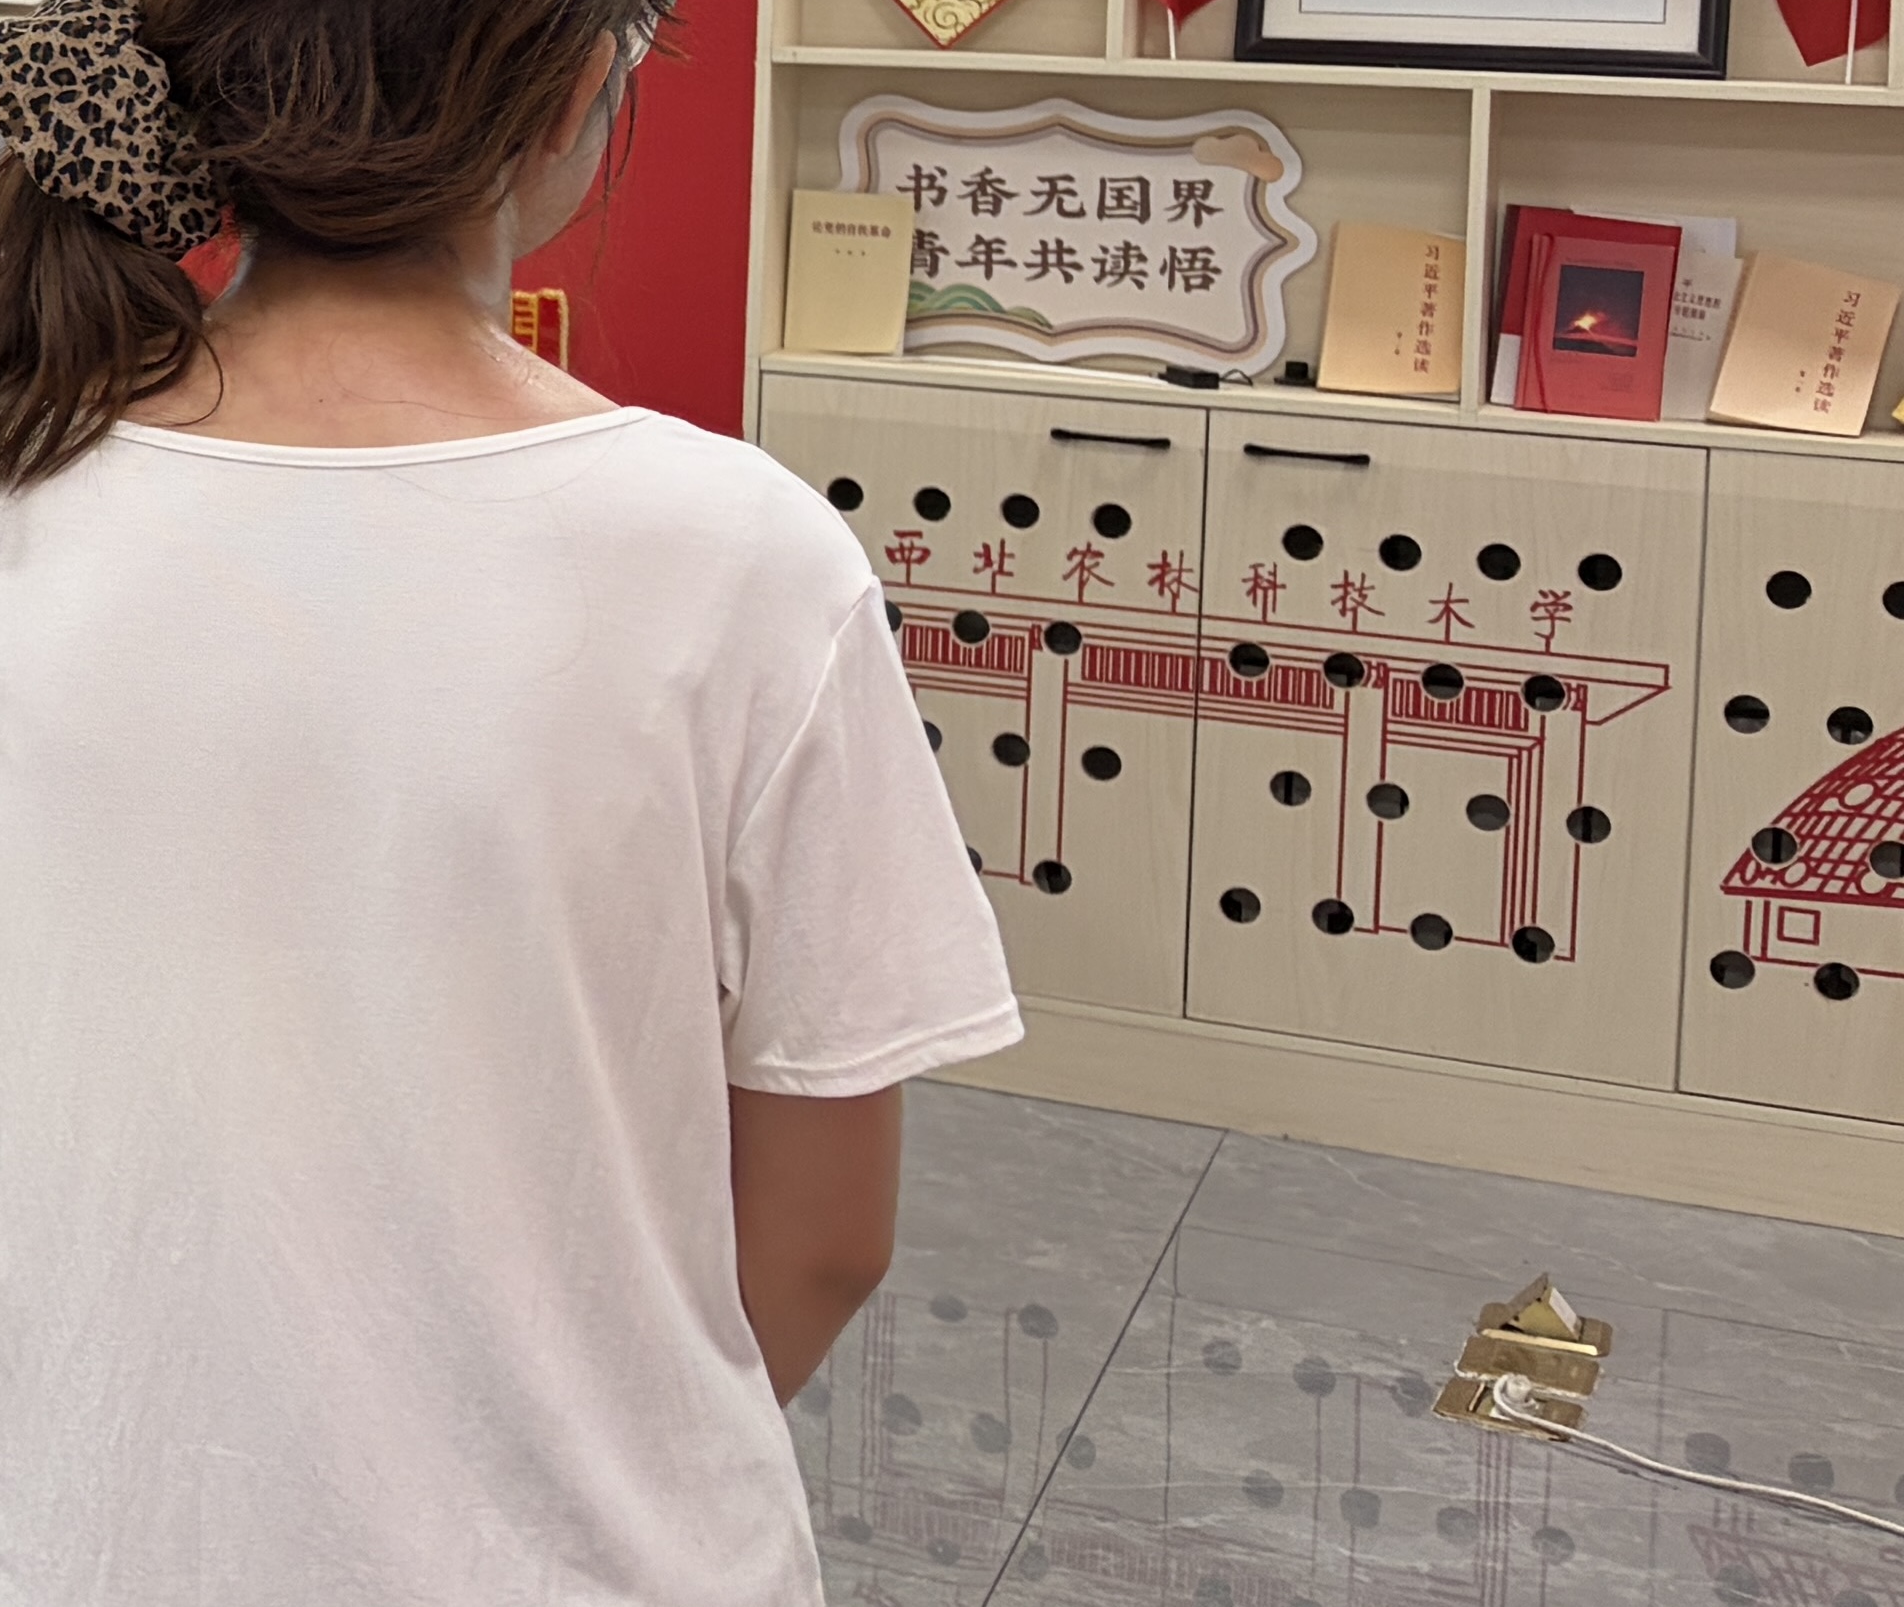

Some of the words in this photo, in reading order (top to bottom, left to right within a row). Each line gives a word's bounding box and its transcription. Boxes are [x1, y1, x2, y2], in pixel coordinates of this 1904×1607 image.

[896, 163, 1224, 228] 书香无国界
[908, 228, 1223, 294] 青年共读悟
[1414, 245, 1440, 374] 习近平著作选读
[1812, 289, 1862, 416] 习近平著作选读
